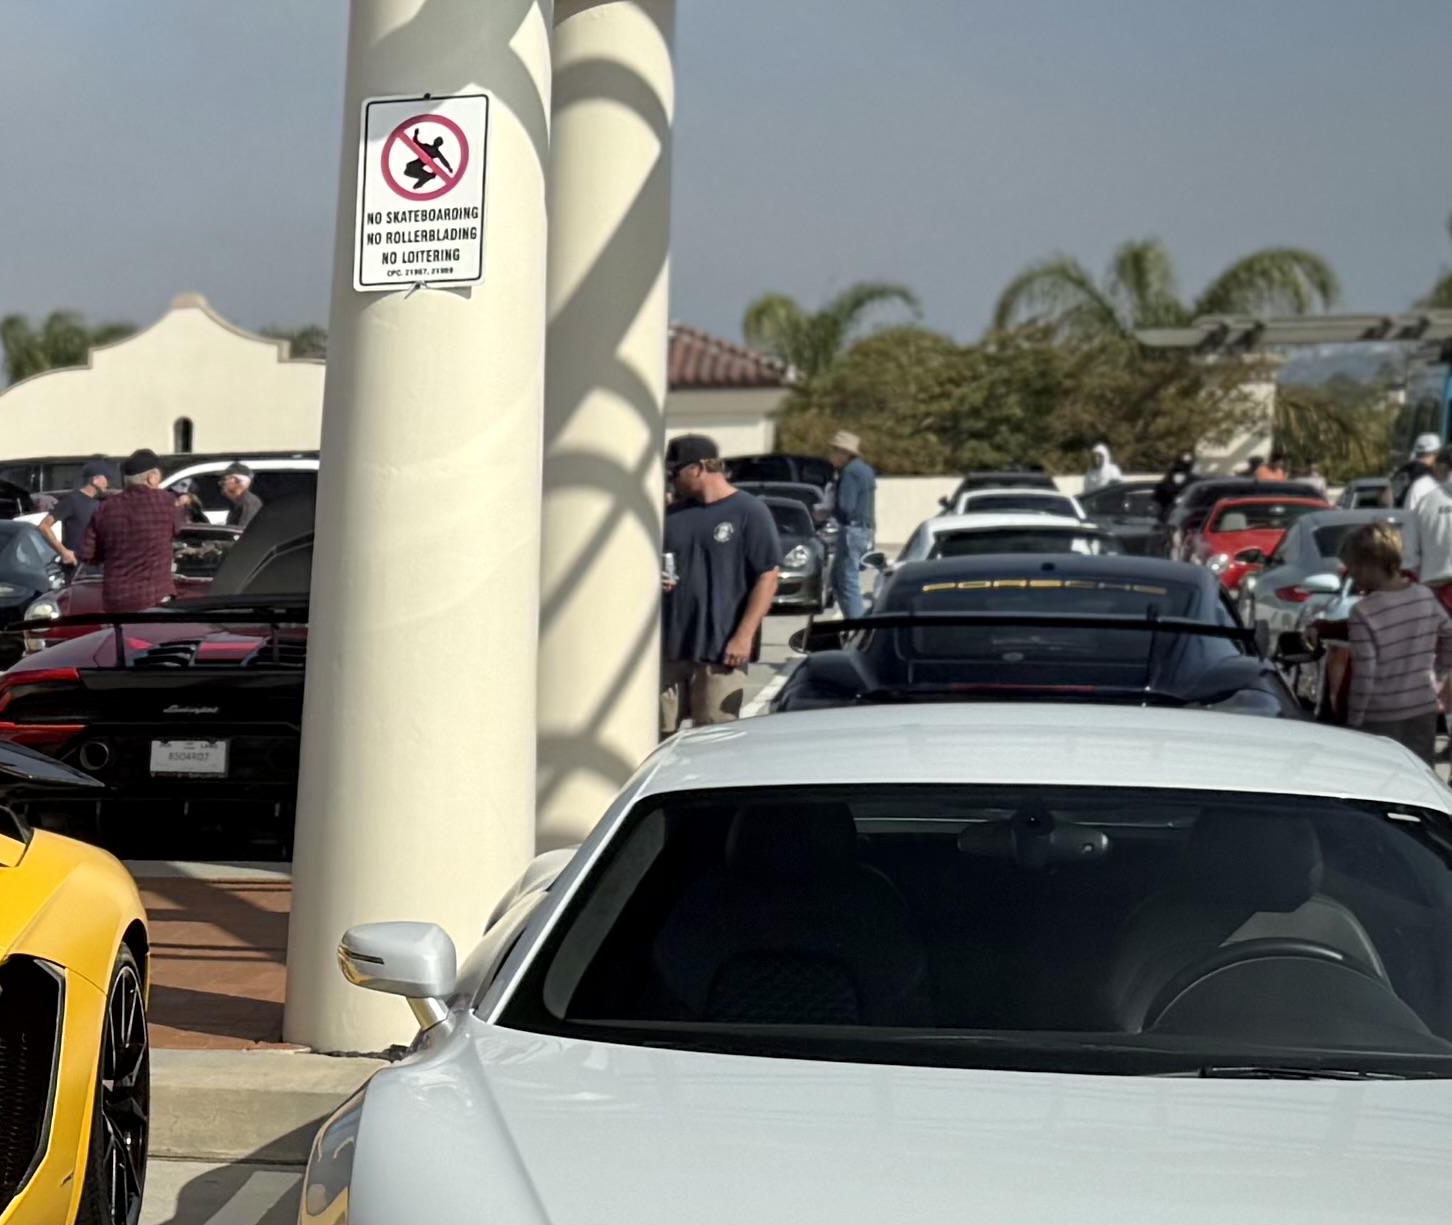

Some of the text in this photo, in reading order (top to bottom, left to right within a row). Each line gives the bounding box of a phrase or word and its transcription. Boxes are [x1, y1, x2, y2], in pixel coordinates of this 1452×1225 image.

[367, 206, 479, 225] NO SKATEBOARDING
[367, 227, 477, 246] NO ROLLERBLADING
[381, 248, 460, 265] NO LOITERING
